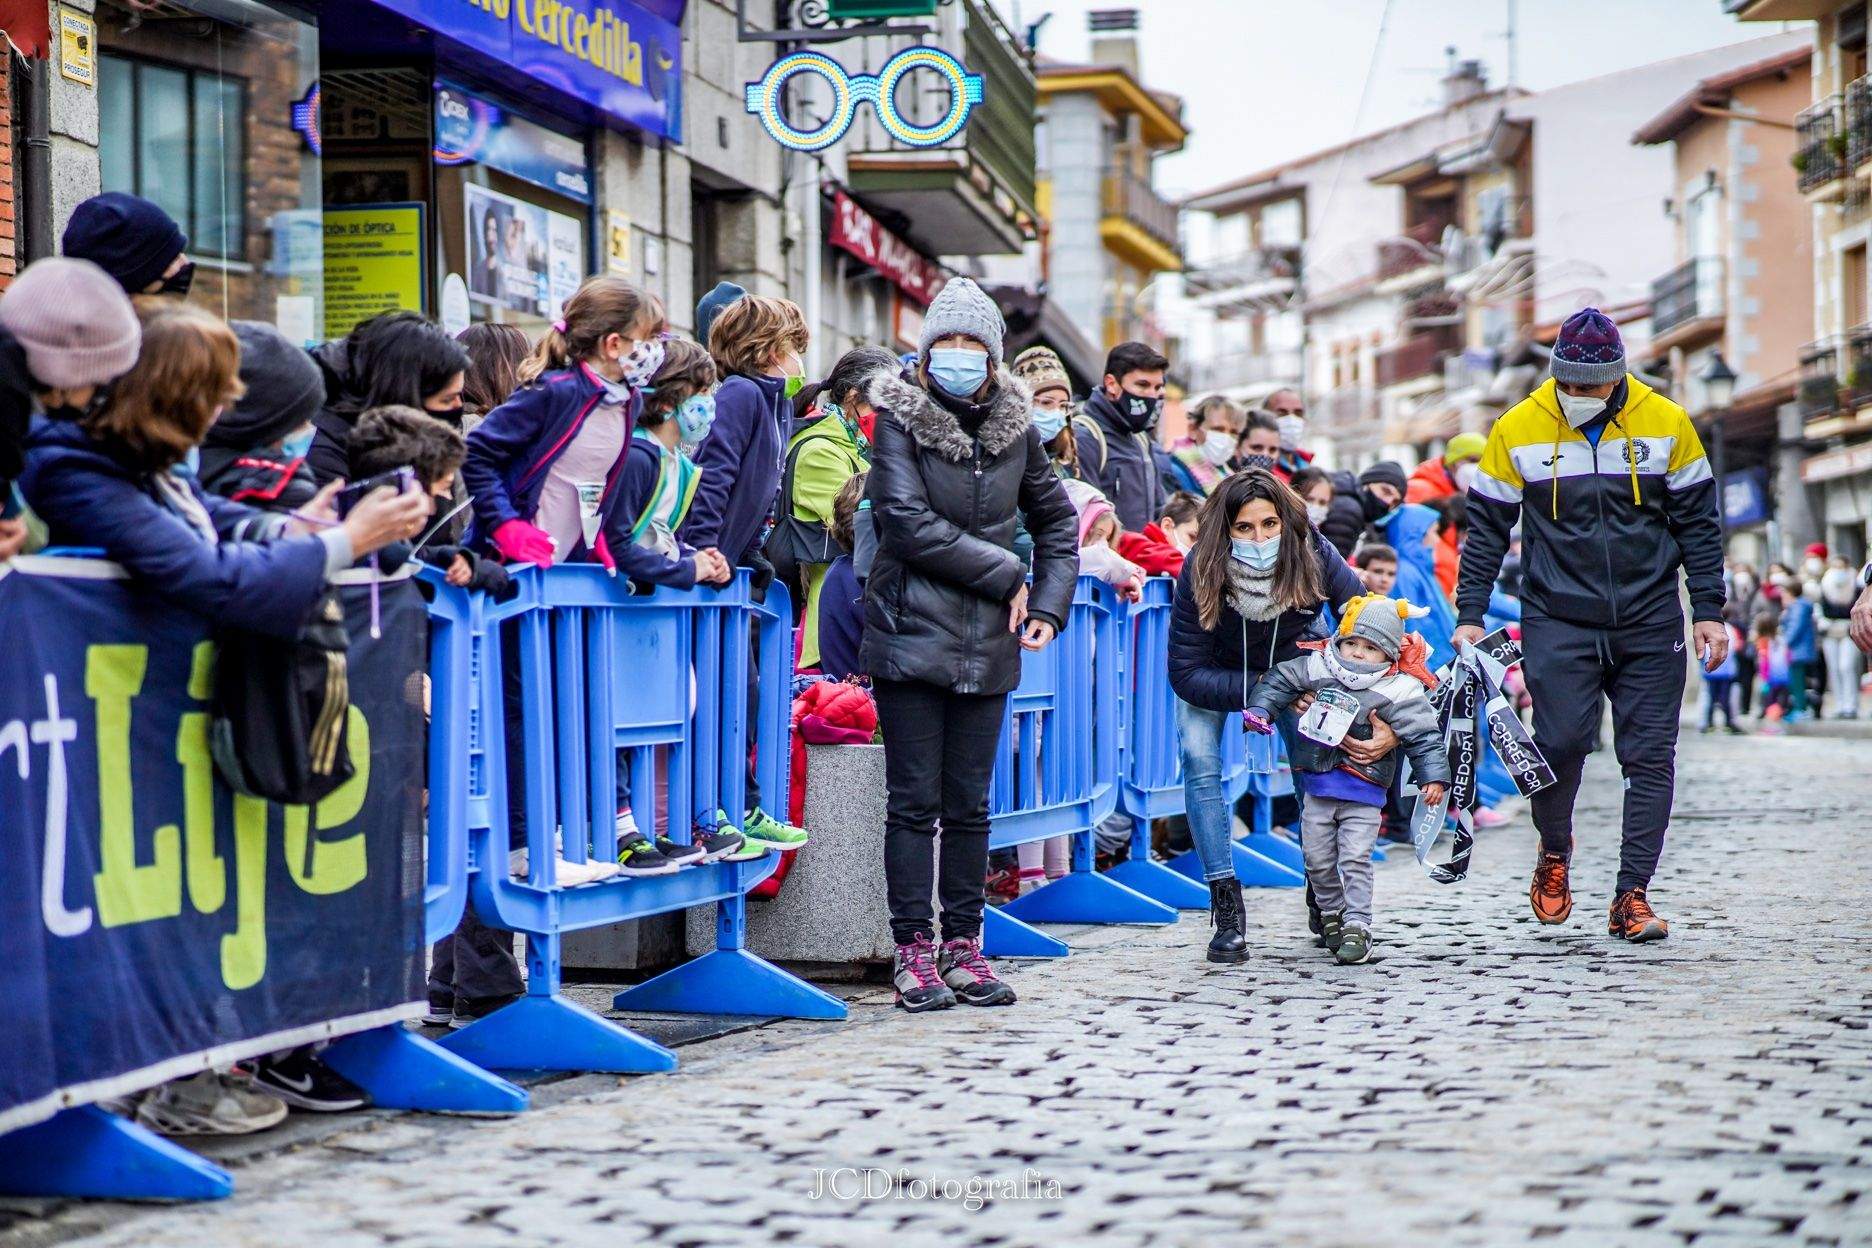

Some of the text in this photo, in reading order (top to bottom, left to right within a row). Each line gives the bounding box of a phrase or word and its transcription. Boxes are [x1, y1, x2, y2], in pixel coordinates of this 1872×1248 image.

[517, 0, 643, 87] Cercedilla
[64, 62, 90, 78] PROSEGUR
[1317, 711, 1328, 730] 1
